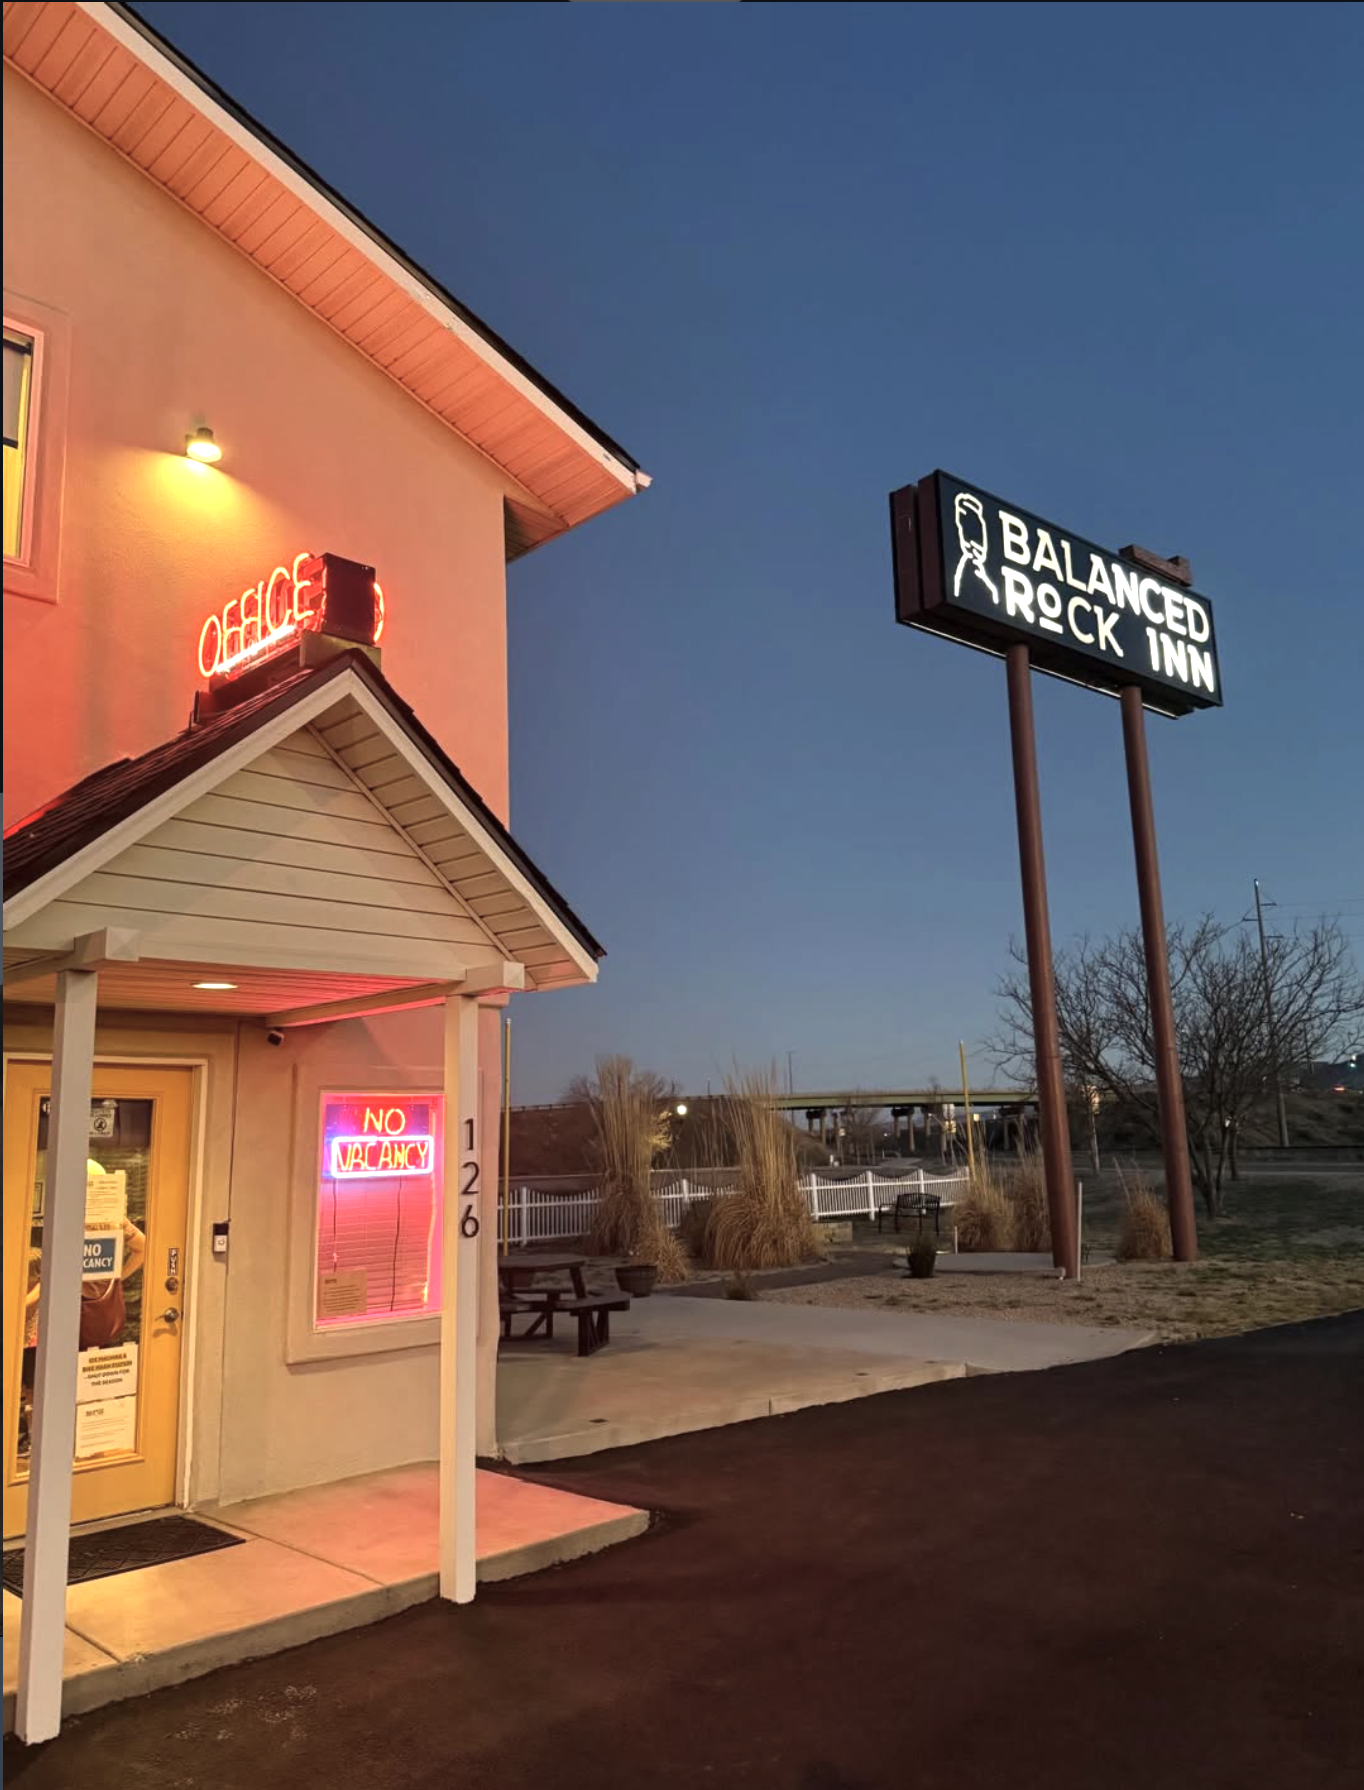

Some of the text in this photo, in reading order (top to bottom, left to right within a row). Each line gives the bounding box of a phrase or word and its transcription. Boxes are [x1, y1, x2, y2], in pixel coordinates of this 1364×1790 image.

[998, 509, 1210, 643] BALANCED
[198, 552, 315, 678] OFFICE
[1146, 626, 1215, 693] INN
[363, 1107, 406, 1136] NO
[336, 1141, 429, 1171] VACANCY
[461, 1118, 480, 1238] 126
[83, 1243, 102, 1257] NO
[83, 1256, 113, 1268] CANCY
